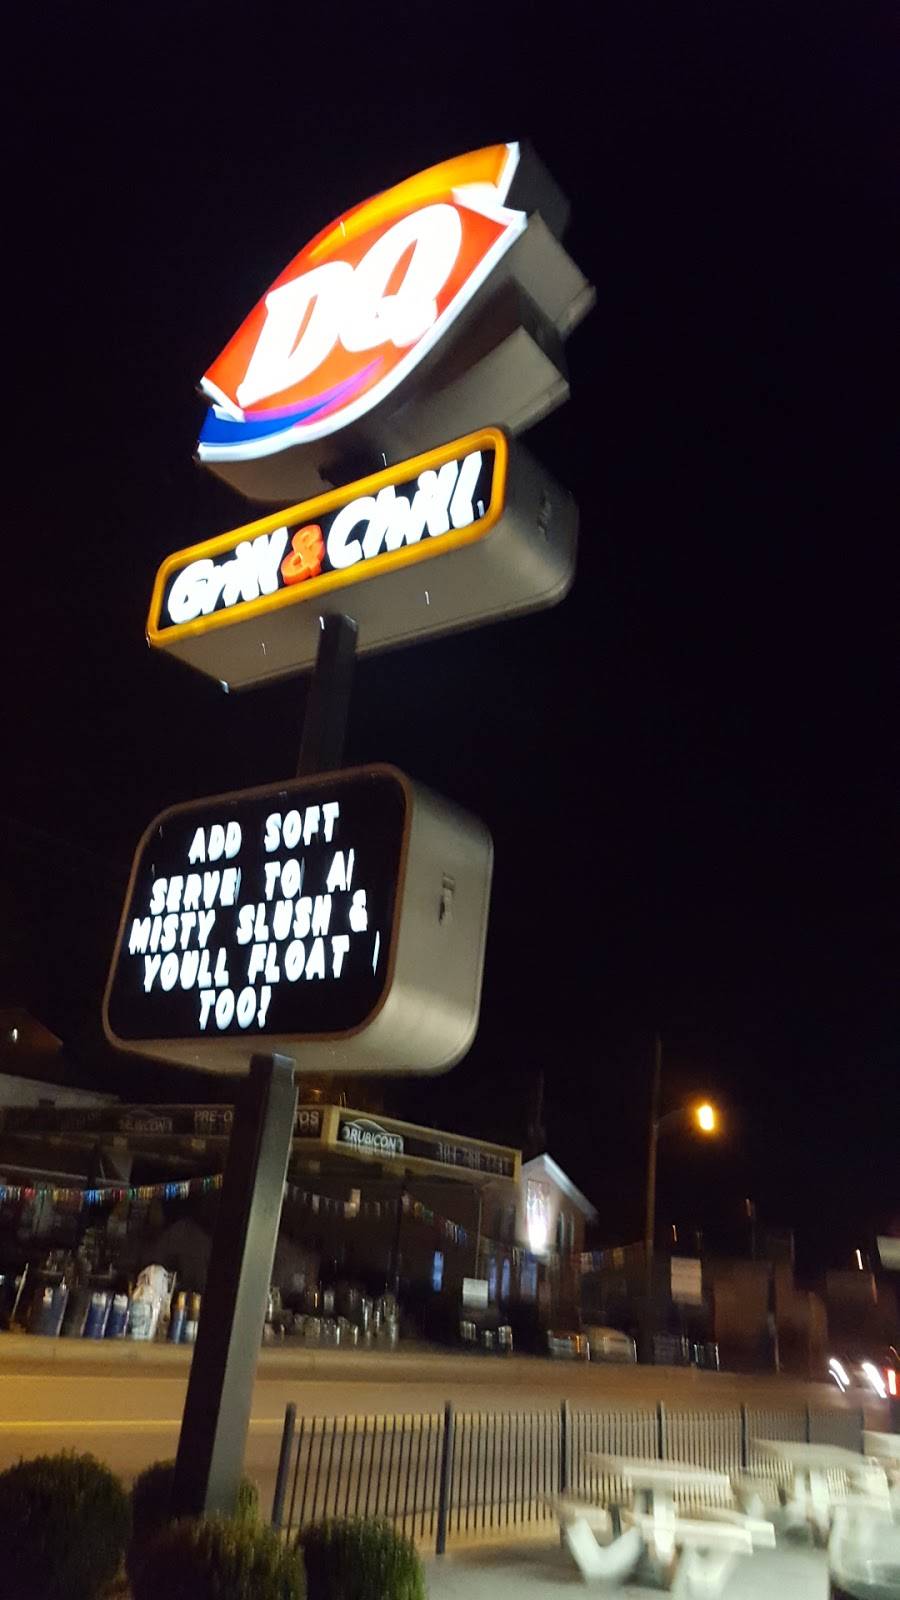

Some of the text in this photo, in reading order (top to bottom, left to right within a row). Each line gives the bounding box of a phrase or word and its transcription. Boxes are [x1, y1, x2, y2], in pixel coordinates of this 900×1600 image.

[236, 203, 463, 407] DQ
[167, 450, 483, 625] Grill & Chill
[187, 801, 340, 866] ADD SOFT
[149, 866, 239, 917] SERVE
[264, 858, 302, 902] TO
[128, 889, 369, 956] MISTY SLUSH &
[143, 934, 350, 994] YOULL FLOAT
[199, 985, 272, 1031] TOO!
[350, 1127, 397, 1151] RUBICON
